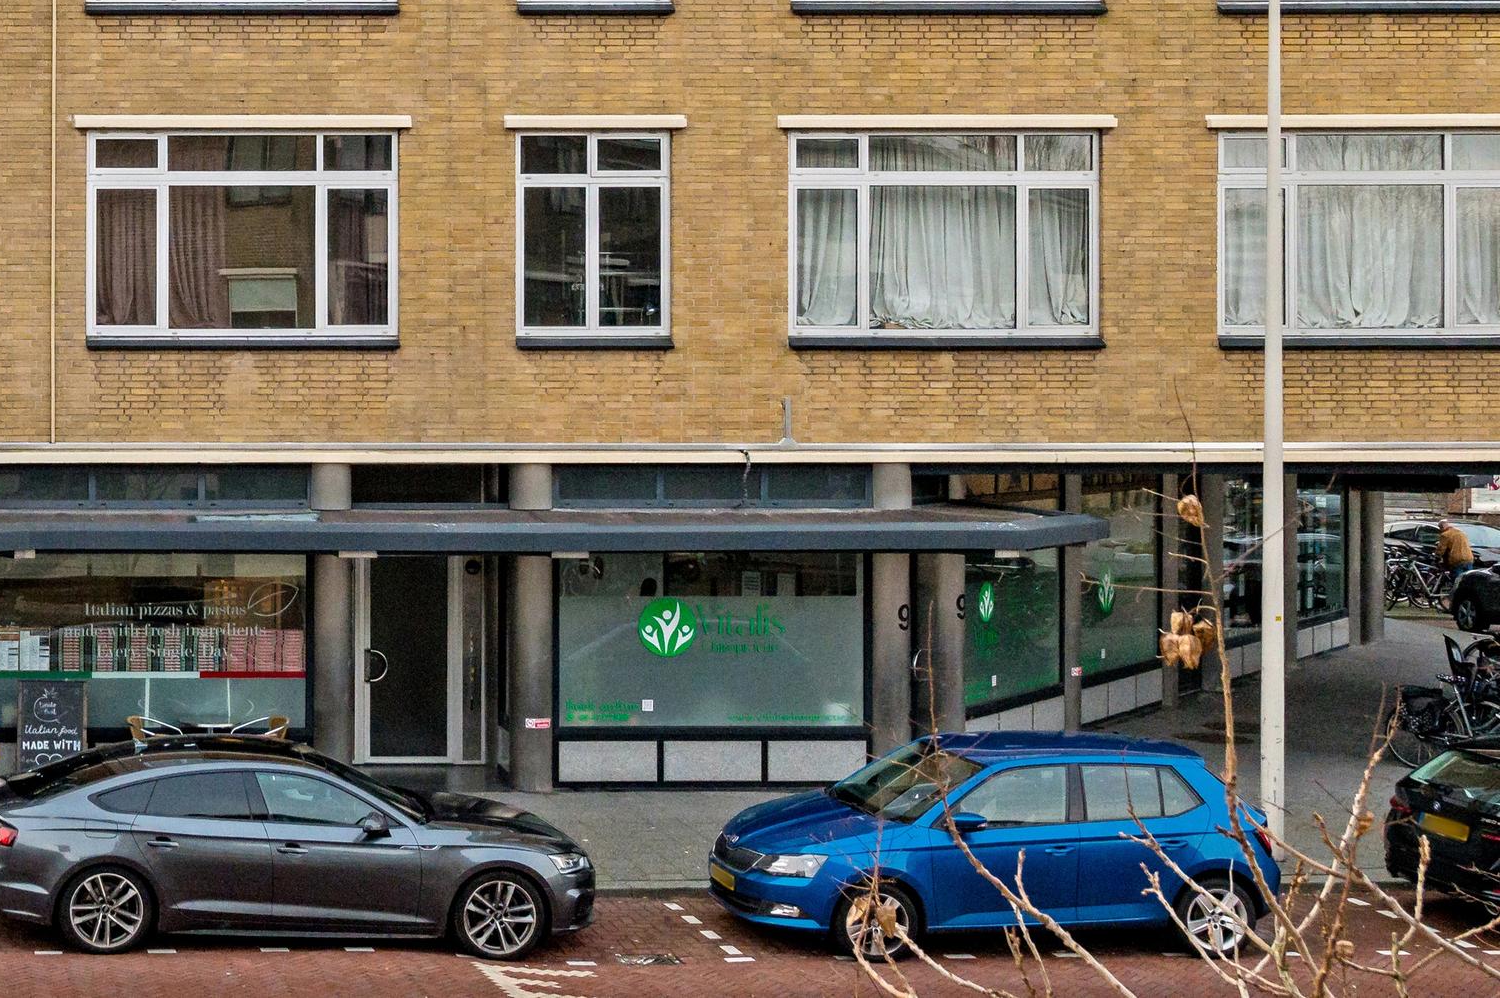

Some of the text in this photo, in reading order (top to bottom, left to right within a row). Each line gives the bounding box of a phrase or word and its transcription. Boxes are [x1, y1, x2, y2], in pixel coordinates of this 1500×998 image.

[85, 602, 246, 620] Italian pizzas & pastas
[898, 603, 910, 631] 9
[64, 623, 266, 640] made with fresh ingredients
[22, 740, 49, 750] MADE
